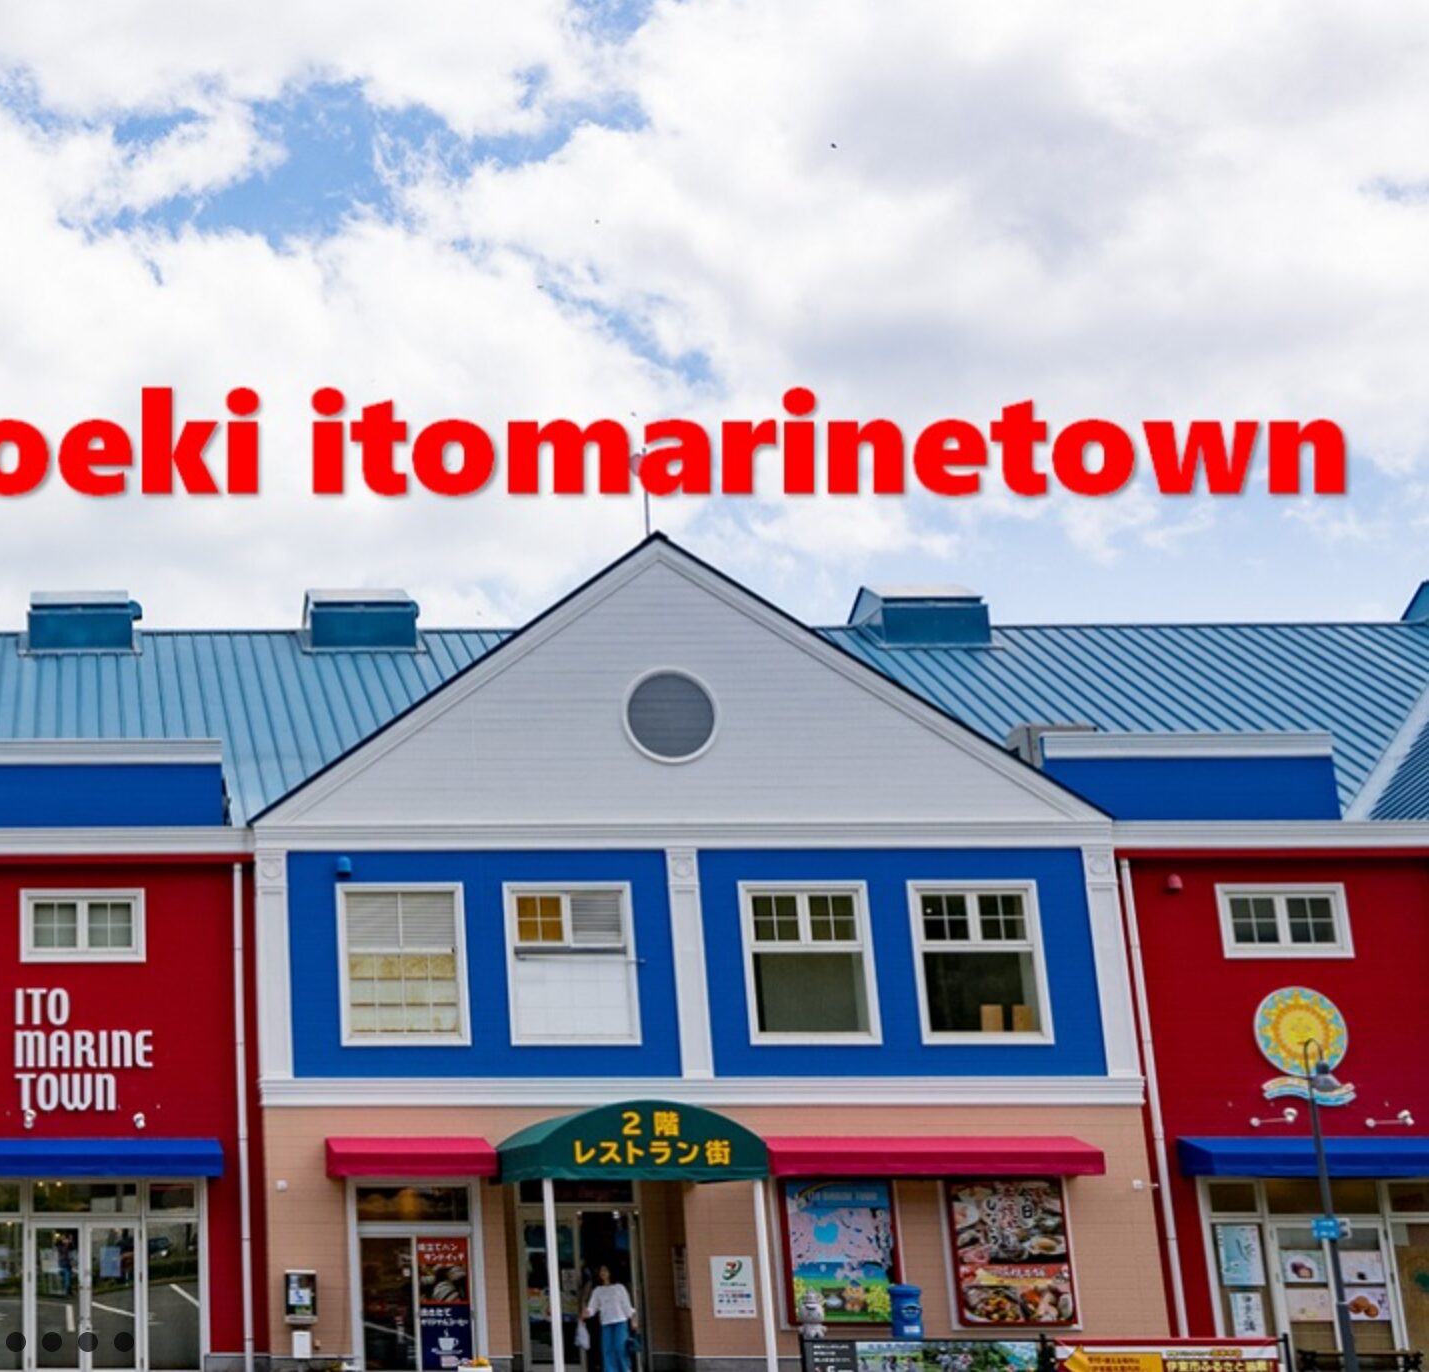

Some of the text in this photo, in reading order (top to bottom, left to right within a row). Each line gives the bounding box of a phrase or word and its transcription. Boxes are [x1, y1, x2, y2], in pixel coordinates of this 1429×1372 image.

[15, 988, 70, 1026] ITO
[15, 1030, 154, 1068] MARINE
[15, 1073, 117, 1112] TOWN
[574, 1140, 731, 1166] レストラン街
